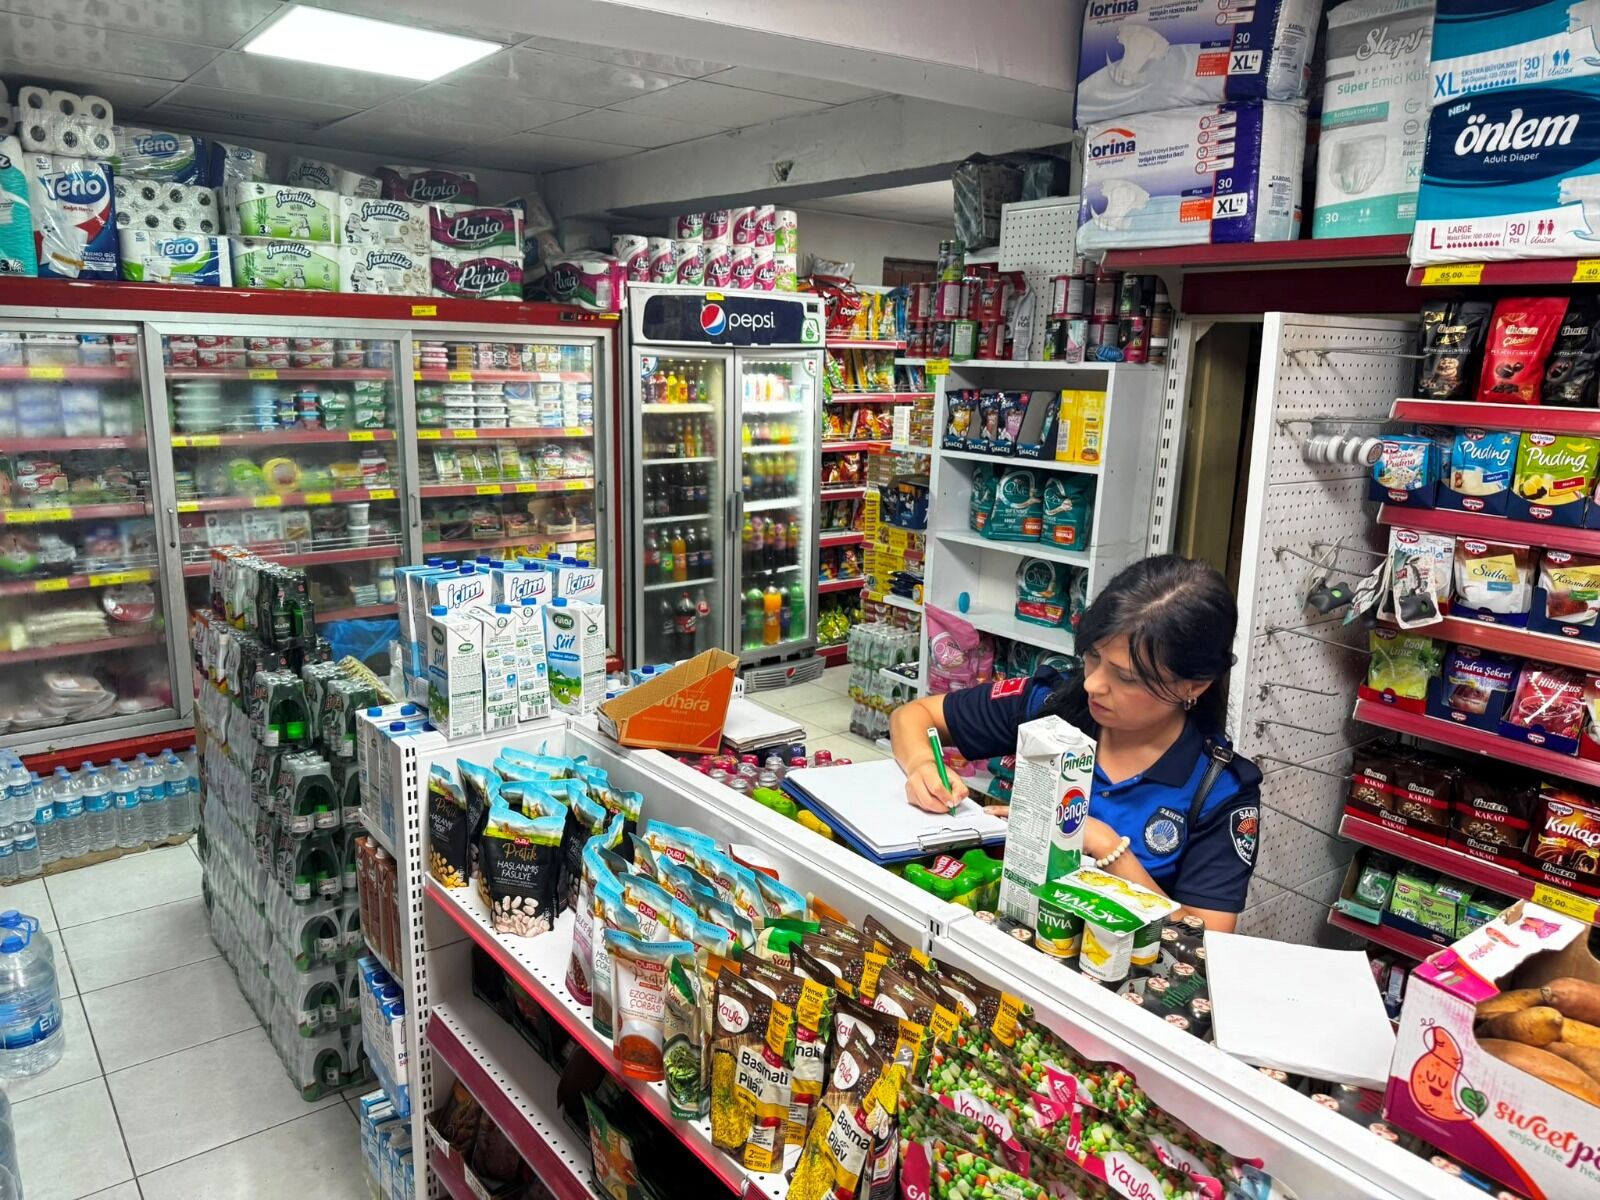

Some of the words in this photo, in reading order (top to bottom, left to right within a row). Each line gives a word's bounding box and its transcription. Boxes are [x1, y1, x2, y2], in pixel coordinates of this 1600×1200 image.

[1236, 33, 1250, 44] 30
[1355, 26, 1424, 61] Sleepy
[1231, 55, 1252, 71] XL
[1524, 56, 1540, 70] 30
[1337, 80, 1370, 95] Süper
[1372, 73, 1403, 88] Emici
[1524, 71, 1538, 79] Adet
[1433, 72, 1460, 98] XL
[1448, 102, 1471, 117] NEW
[1454, 108, 1580, 156] önlem
[136, 134, 177, 155] Teno
[1483, 154, 1507, 164] Adult
[1509, 152, 1539, 164] Diaper
[43, 171, 102, 200] Teno
[410, 177, 458, 200] Papia
[1218, 178, 1233, 189] 30
[276, 189, 316, 208] familia
[1217, 198, 1238, 213] XL
[361, 202, 410, 222] familia
[1325, 211, 1338, 223] 30
[453, 215, 501, 241] Papia
[1448, 224, 1472, 234] LARGE
[1509, 223, 1525, 236] 30
[1430, 227, 1443, 250] L
[158, 239, 195, 259] Teno
[267, 241, 311, 259] familia
[366, 251, 412, 270] familia
[458, 265, 506, 292] Papia
[728, 311, 775, 332] pepsi
[1461, 441, 1511, 466] Puding
[1526, 446, 1587, 473] Puding
[511, 576, 545, 601] İçim
[566, 572, 595, 595] İçim
[448, 580, 482, 609] İçim
[553, 633, 576, 650] Süt
[1403, 638, 1425, 650] Cool
[1455, 660, 1483, 673] Pudra
[1484, 666, 1512, 679] Şekeri
[1537, 676, 1583, 693] Hibiscus
[664, 694, 710, 712] uhara
[1364, 778, 1384, 789] KAKAO
[1408, 792, 1432, 804] KAKAO
[1056, 799, 1089, 826] Denge
[1474, 810, 1505, 823] KAKAO
[1381, 819, 1405, 831] KAKAO
[1545, 816, 1600, 845] Kakao
[502, 842, 537, 861] Pratik
[666, 847, 686, 861] DURU
[1469, 848, 1495, 861] KAKAO
[497, 860, 540, 875] HAŞLANMIŞ
[501, 868, 533, 881] FASULYE
[1544, 873, 1572, 887] KAKAO
[639, 903, 658, 919] DURU
[1052, 888, 1125, 924] ACTIVIA
[636, 960, 662, 971] DURU
[805, 985, 824, 999] Yemek
[719, 1002, 744, 1028] Yayla
[934, 1012, 955, 1027] Yemek
[899, 1025, 922, 1039] Yemek
[741, 1051, 790, 1086] Basmati
[738, 1072, 764, 1098] Pilav
[957, 1096, 1005, 1139] Yayla
[836, 1109, 871, 1150] Basma
[827, 1130, 849, 1163] Pilav
[1508, 1129, 1541, 1152] enjoy
[1543, 1144, 1564, 1162] life
